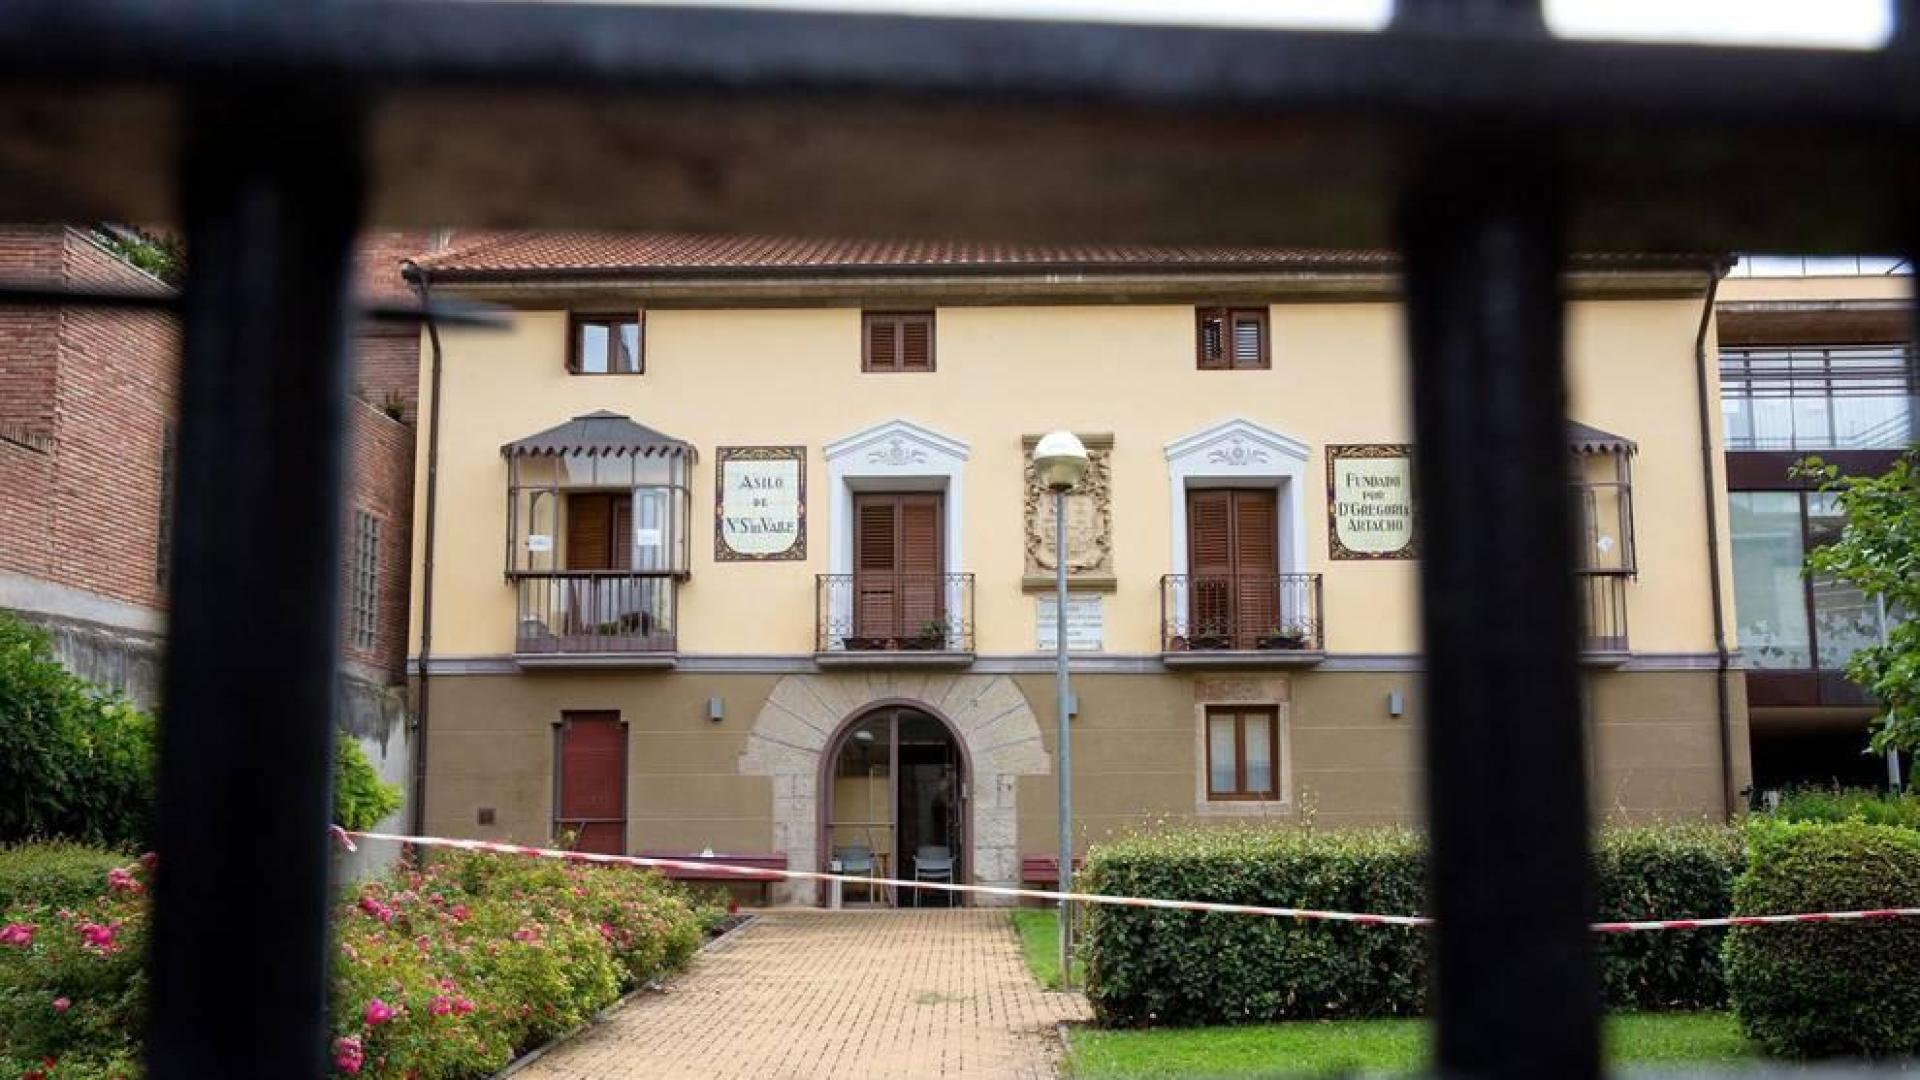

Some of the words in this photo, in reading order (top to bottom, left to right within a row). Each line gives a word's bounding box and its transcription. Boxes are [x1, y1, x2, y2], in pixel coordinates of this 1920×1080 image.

[739, 474, 783, 489] ASILO
[1345, 472, 1401, 487] FUNDADO
[752, 497, 769, 507] DE
